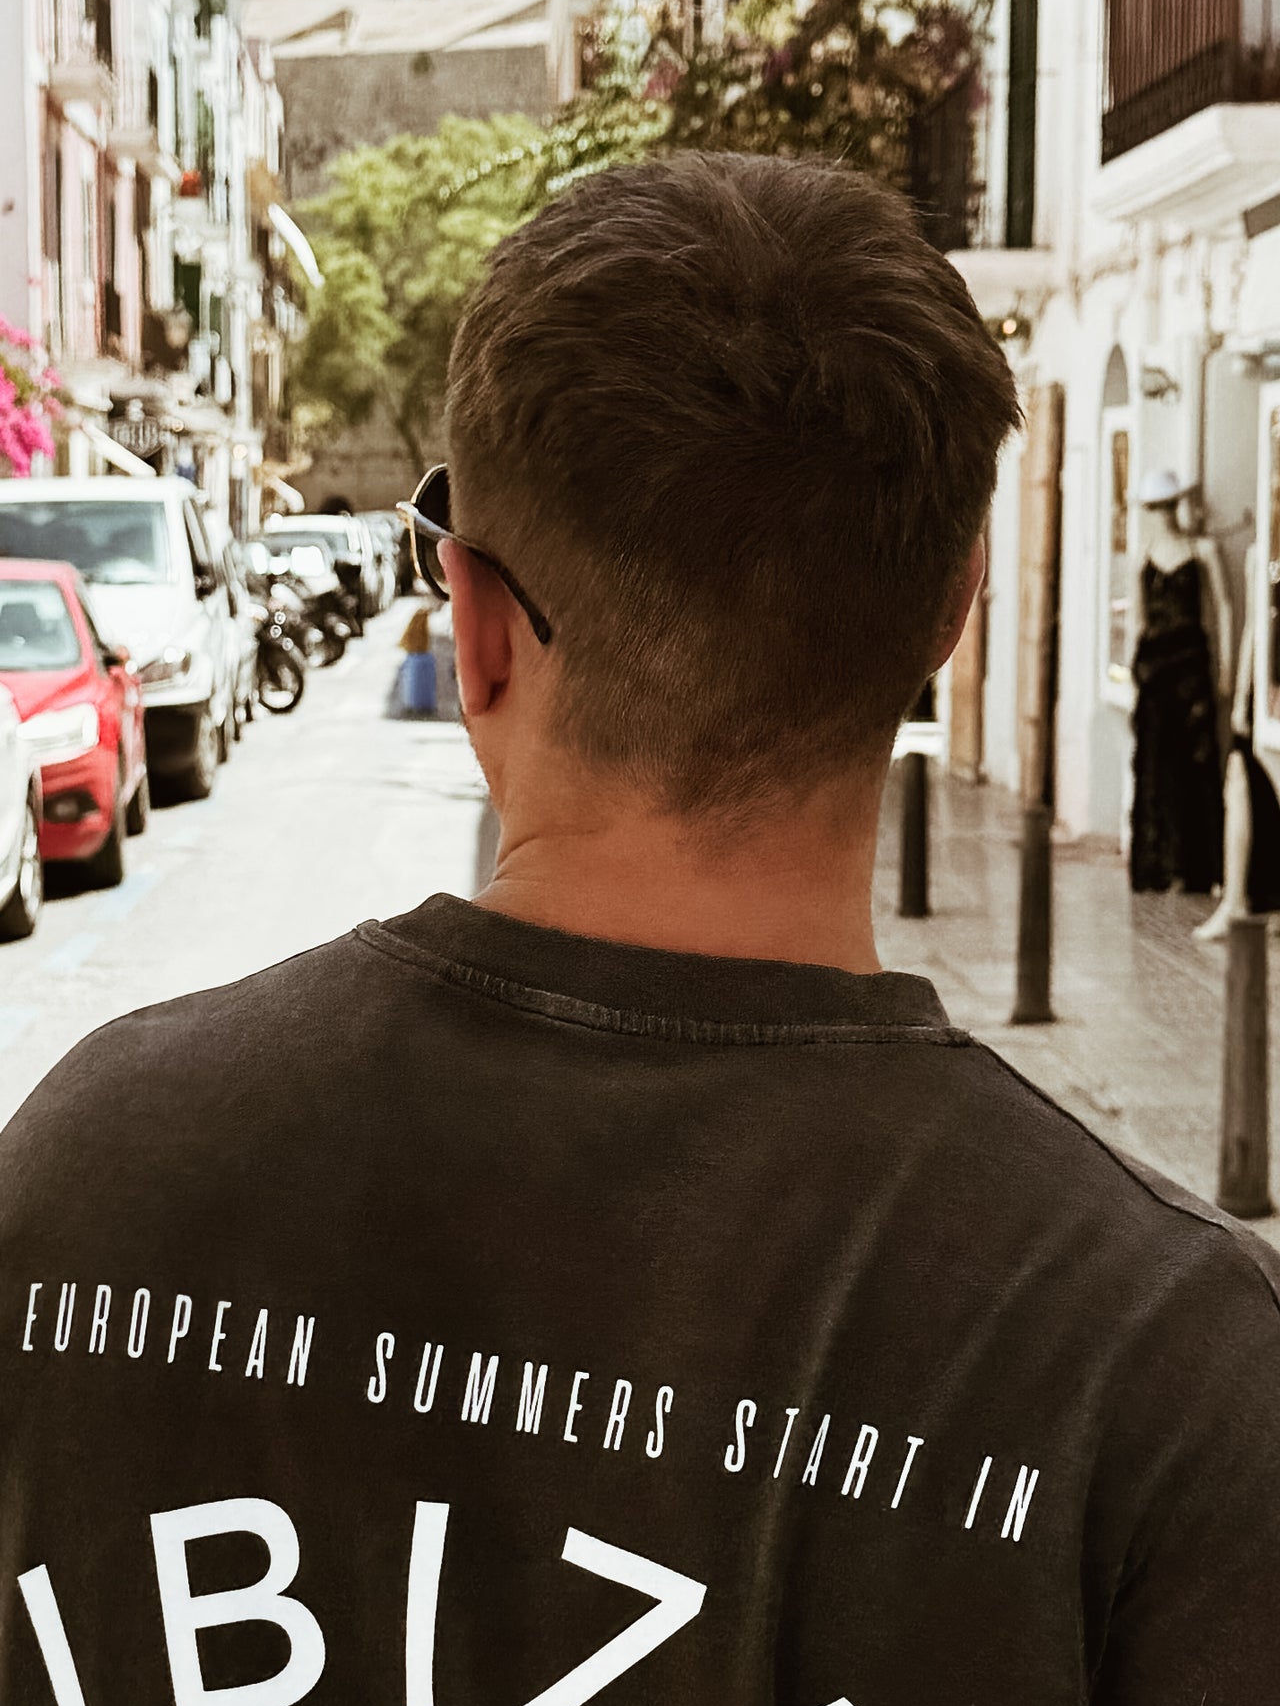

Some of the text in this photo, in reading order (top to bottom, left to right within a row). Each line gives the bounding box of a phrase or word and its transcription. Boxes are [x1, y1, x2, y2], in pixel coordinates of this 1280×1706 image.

[21, 1282, 1041, 1543] EUROPEAN SUMMERS START IN
